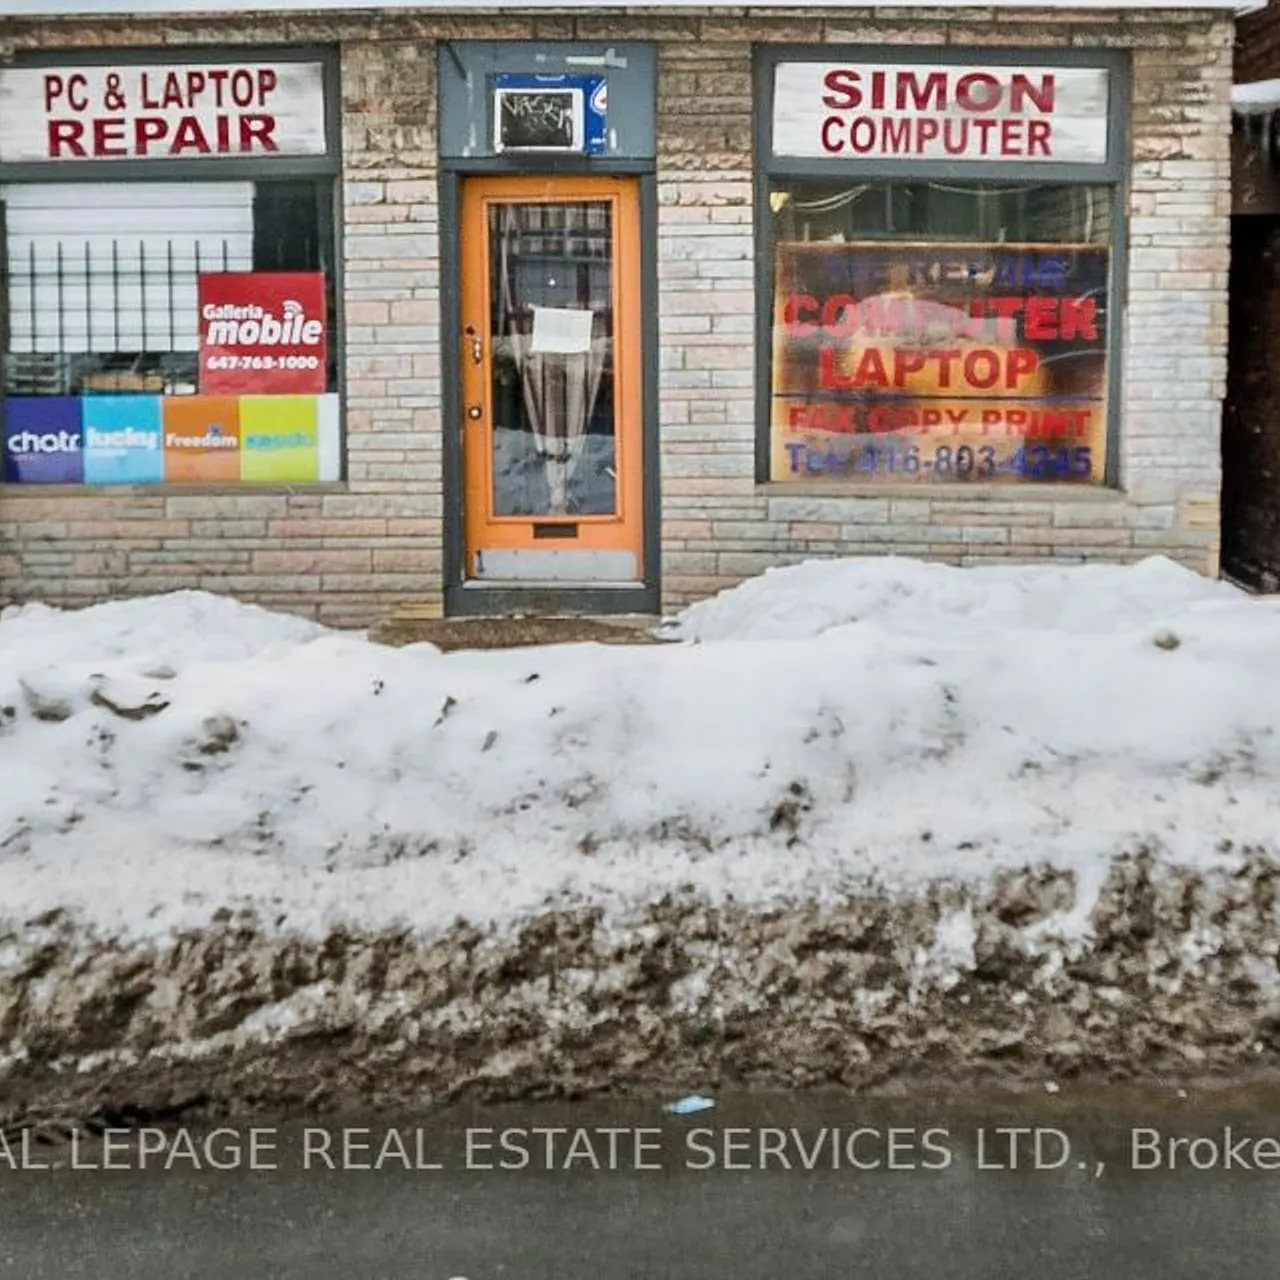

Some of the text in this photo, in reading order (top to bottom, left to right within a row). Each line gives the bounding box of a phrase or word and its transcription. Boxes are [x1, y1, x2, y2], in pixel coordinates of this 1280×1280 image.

[44, 69, 278, 113] PC & LAPTOP
[821, 69, 1056, 113] SIMON
[47, 113, 280, 158] REPAIR
[821, 115, 1053, 157] COMPUTER
[202, 304, 264, 320] Galleria
[206, 313, 323, 345] mobile
[820, 346, 1041, 390] LAPTOP
[166, 432, 238, 448] Freedom
[788, 406, 1091, 438] FAX COPY PRINT
